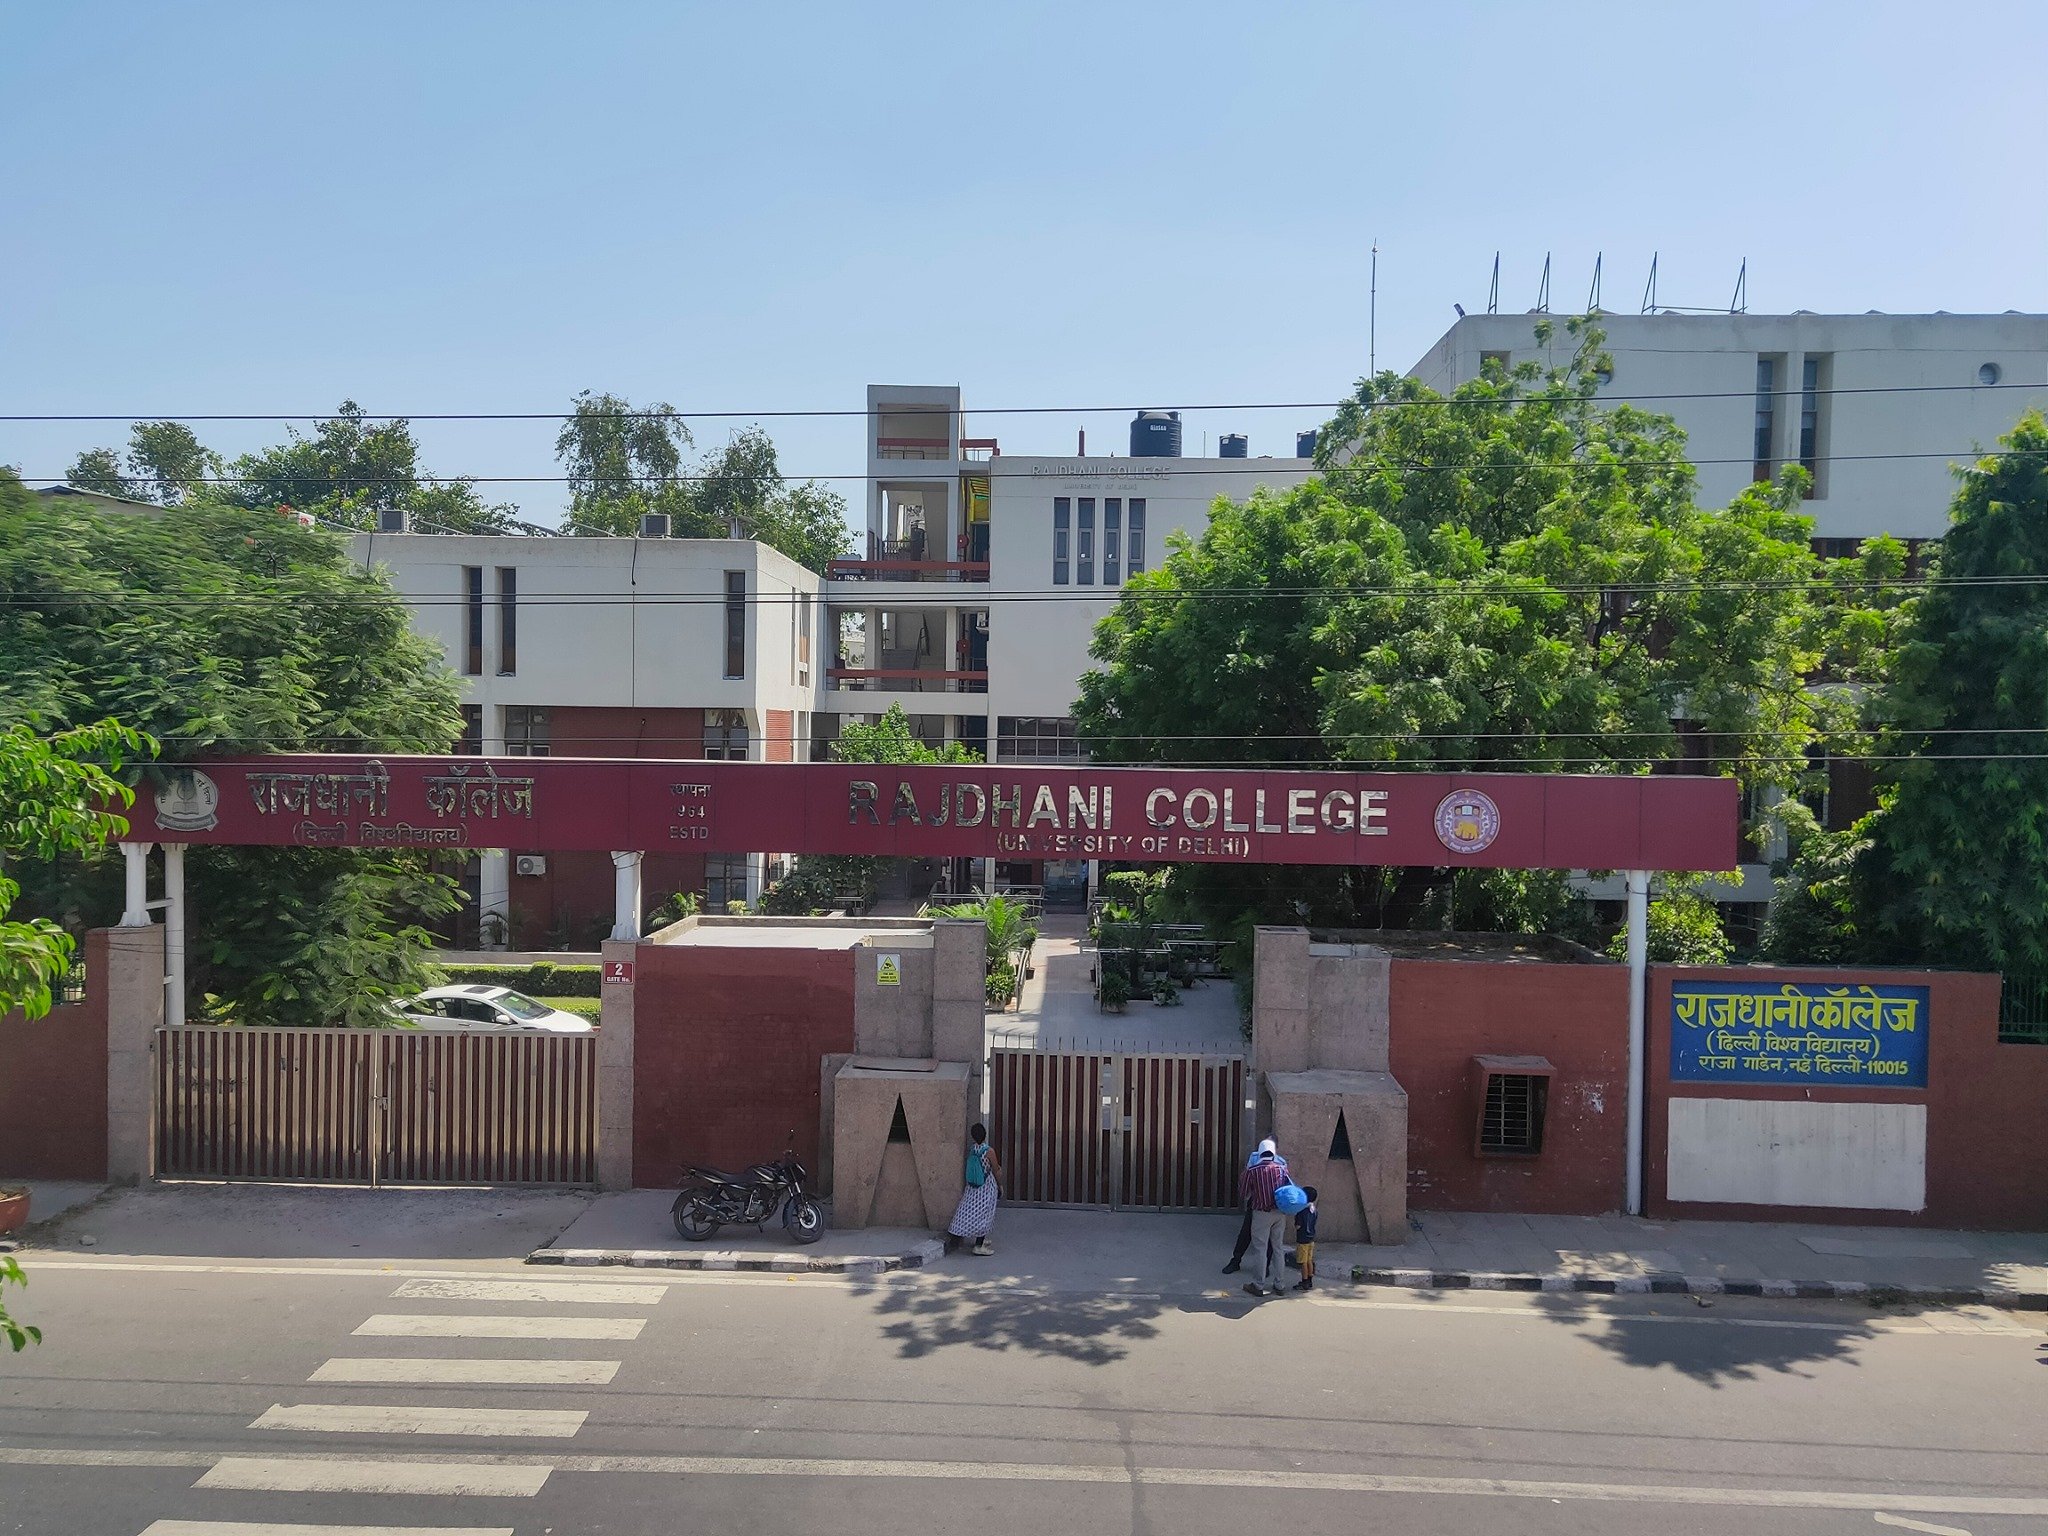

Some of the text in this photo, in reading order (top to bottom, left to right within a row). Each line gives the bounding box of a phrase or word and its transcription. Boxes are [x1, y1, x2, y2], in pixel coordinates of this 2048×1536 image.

[1031, 465, 1172, 481] RAJDHANI COLLEGE
[245, 759, 391, 817] राजधानी
[422, 761, 535, 819] कॉलेज
[673, 804, 706, 818] 964
[848, 780, 1113, 831] RAJDHANI
[1144, 786, 1389, 836] COLLEGE
[669, 826, 709, 839] ESTD
[996, 831, 1250, 858] (UNVERSITY OF DELHI)
[614, 963, 623, 976] 2
[1673, 983, 1920, 1033] राजधानी कॉलेज
[1698, 1055, 1736, 1072] राजा
